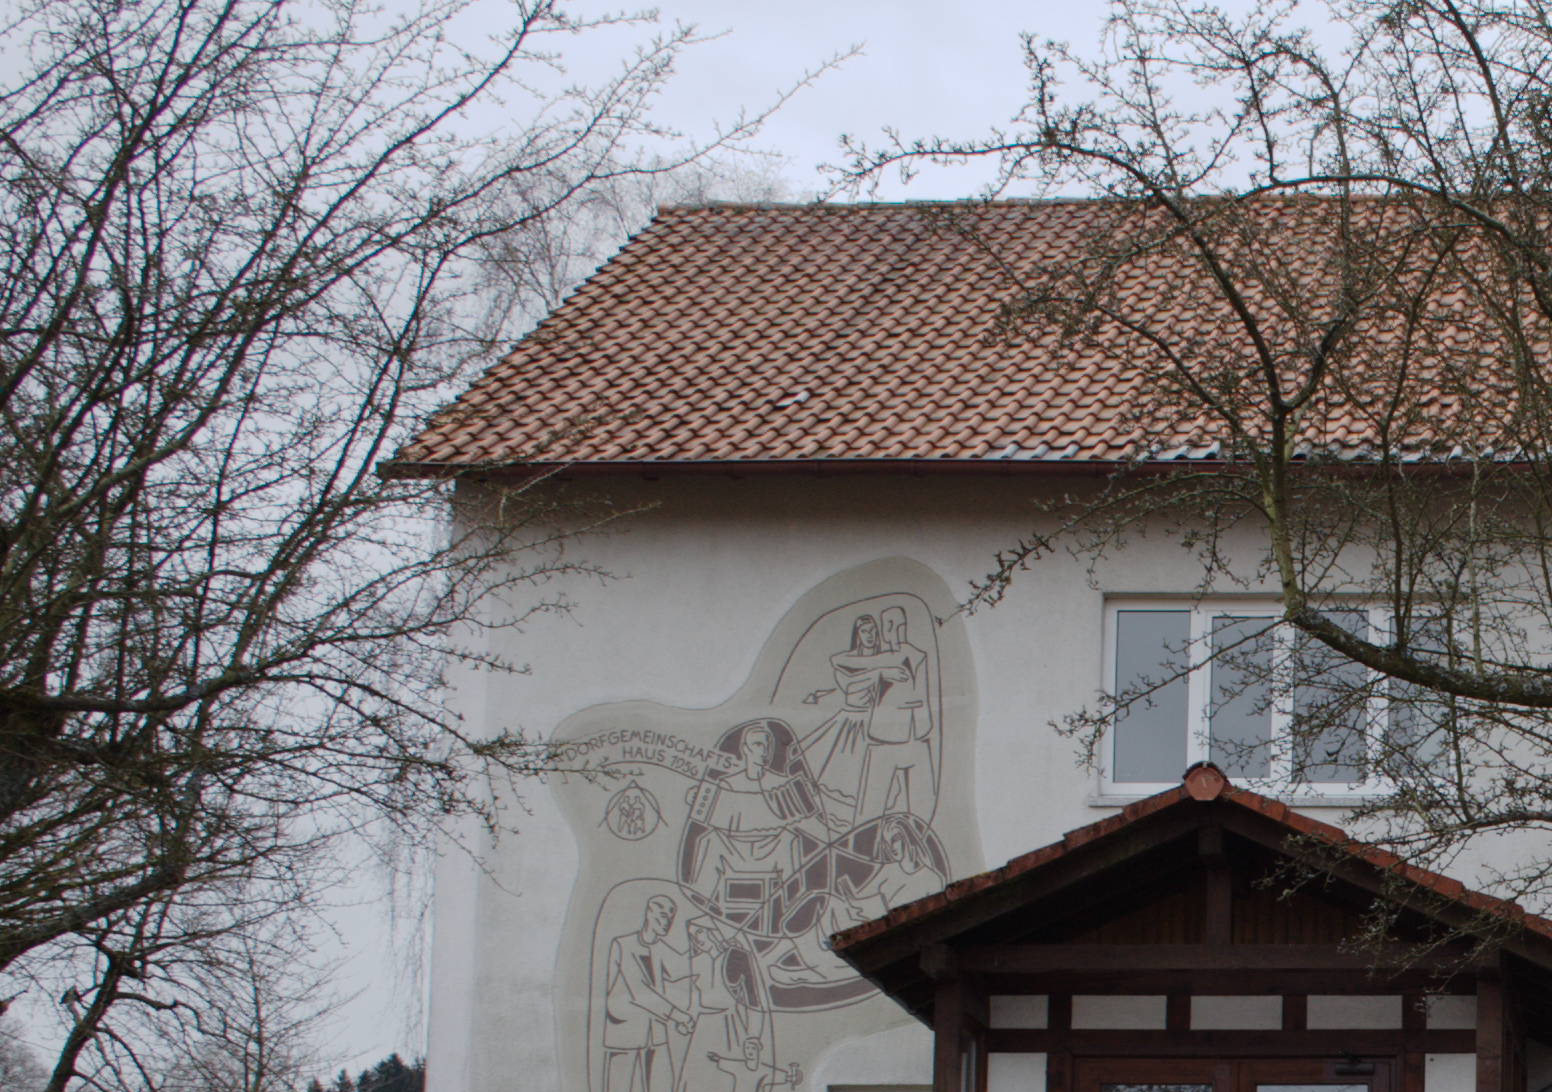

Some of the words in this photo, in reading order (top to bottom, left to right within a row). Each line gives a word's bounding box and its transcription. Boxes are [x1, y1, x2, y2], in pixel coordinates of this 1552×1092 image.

[565, 730, 739, 769] DORFGEMEINSCHAFTS-
[623, 746, 666, 763] HAUS
[671, 755, 699, 777] 1956
